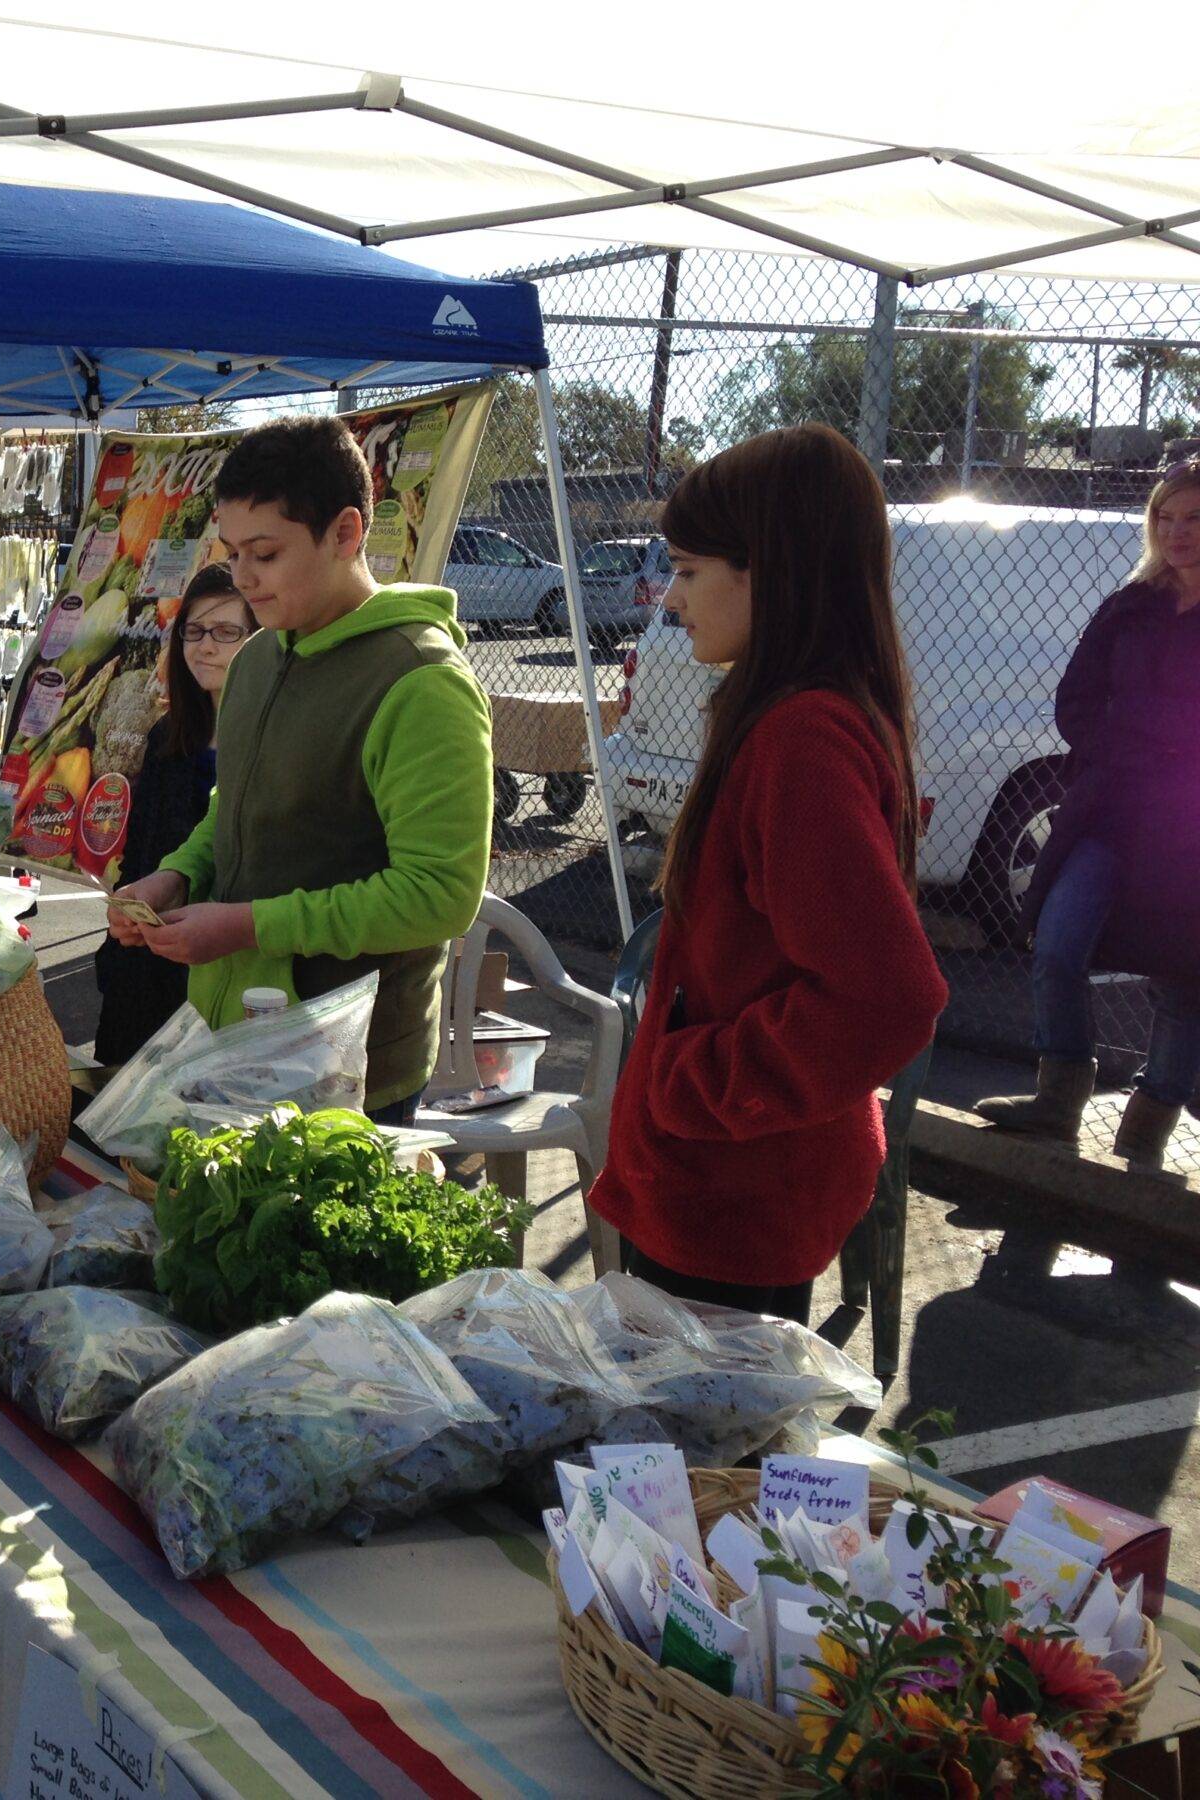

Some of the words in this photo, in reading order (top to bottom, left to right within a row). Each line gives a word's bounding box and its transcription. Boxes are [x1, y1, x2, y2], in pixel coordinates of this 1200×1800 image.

[649, 777, 667, 801] PA
[53, 825, 71, 837] DIP
[767, 1464, 839, 1488] Sunflower
[34, 1731, 65, 1764] Large
[71, 1746, 96, 1785] Bags
[102, 1706, 152, 1788] Prices!
[30, 1753, 63, 1786] Small
